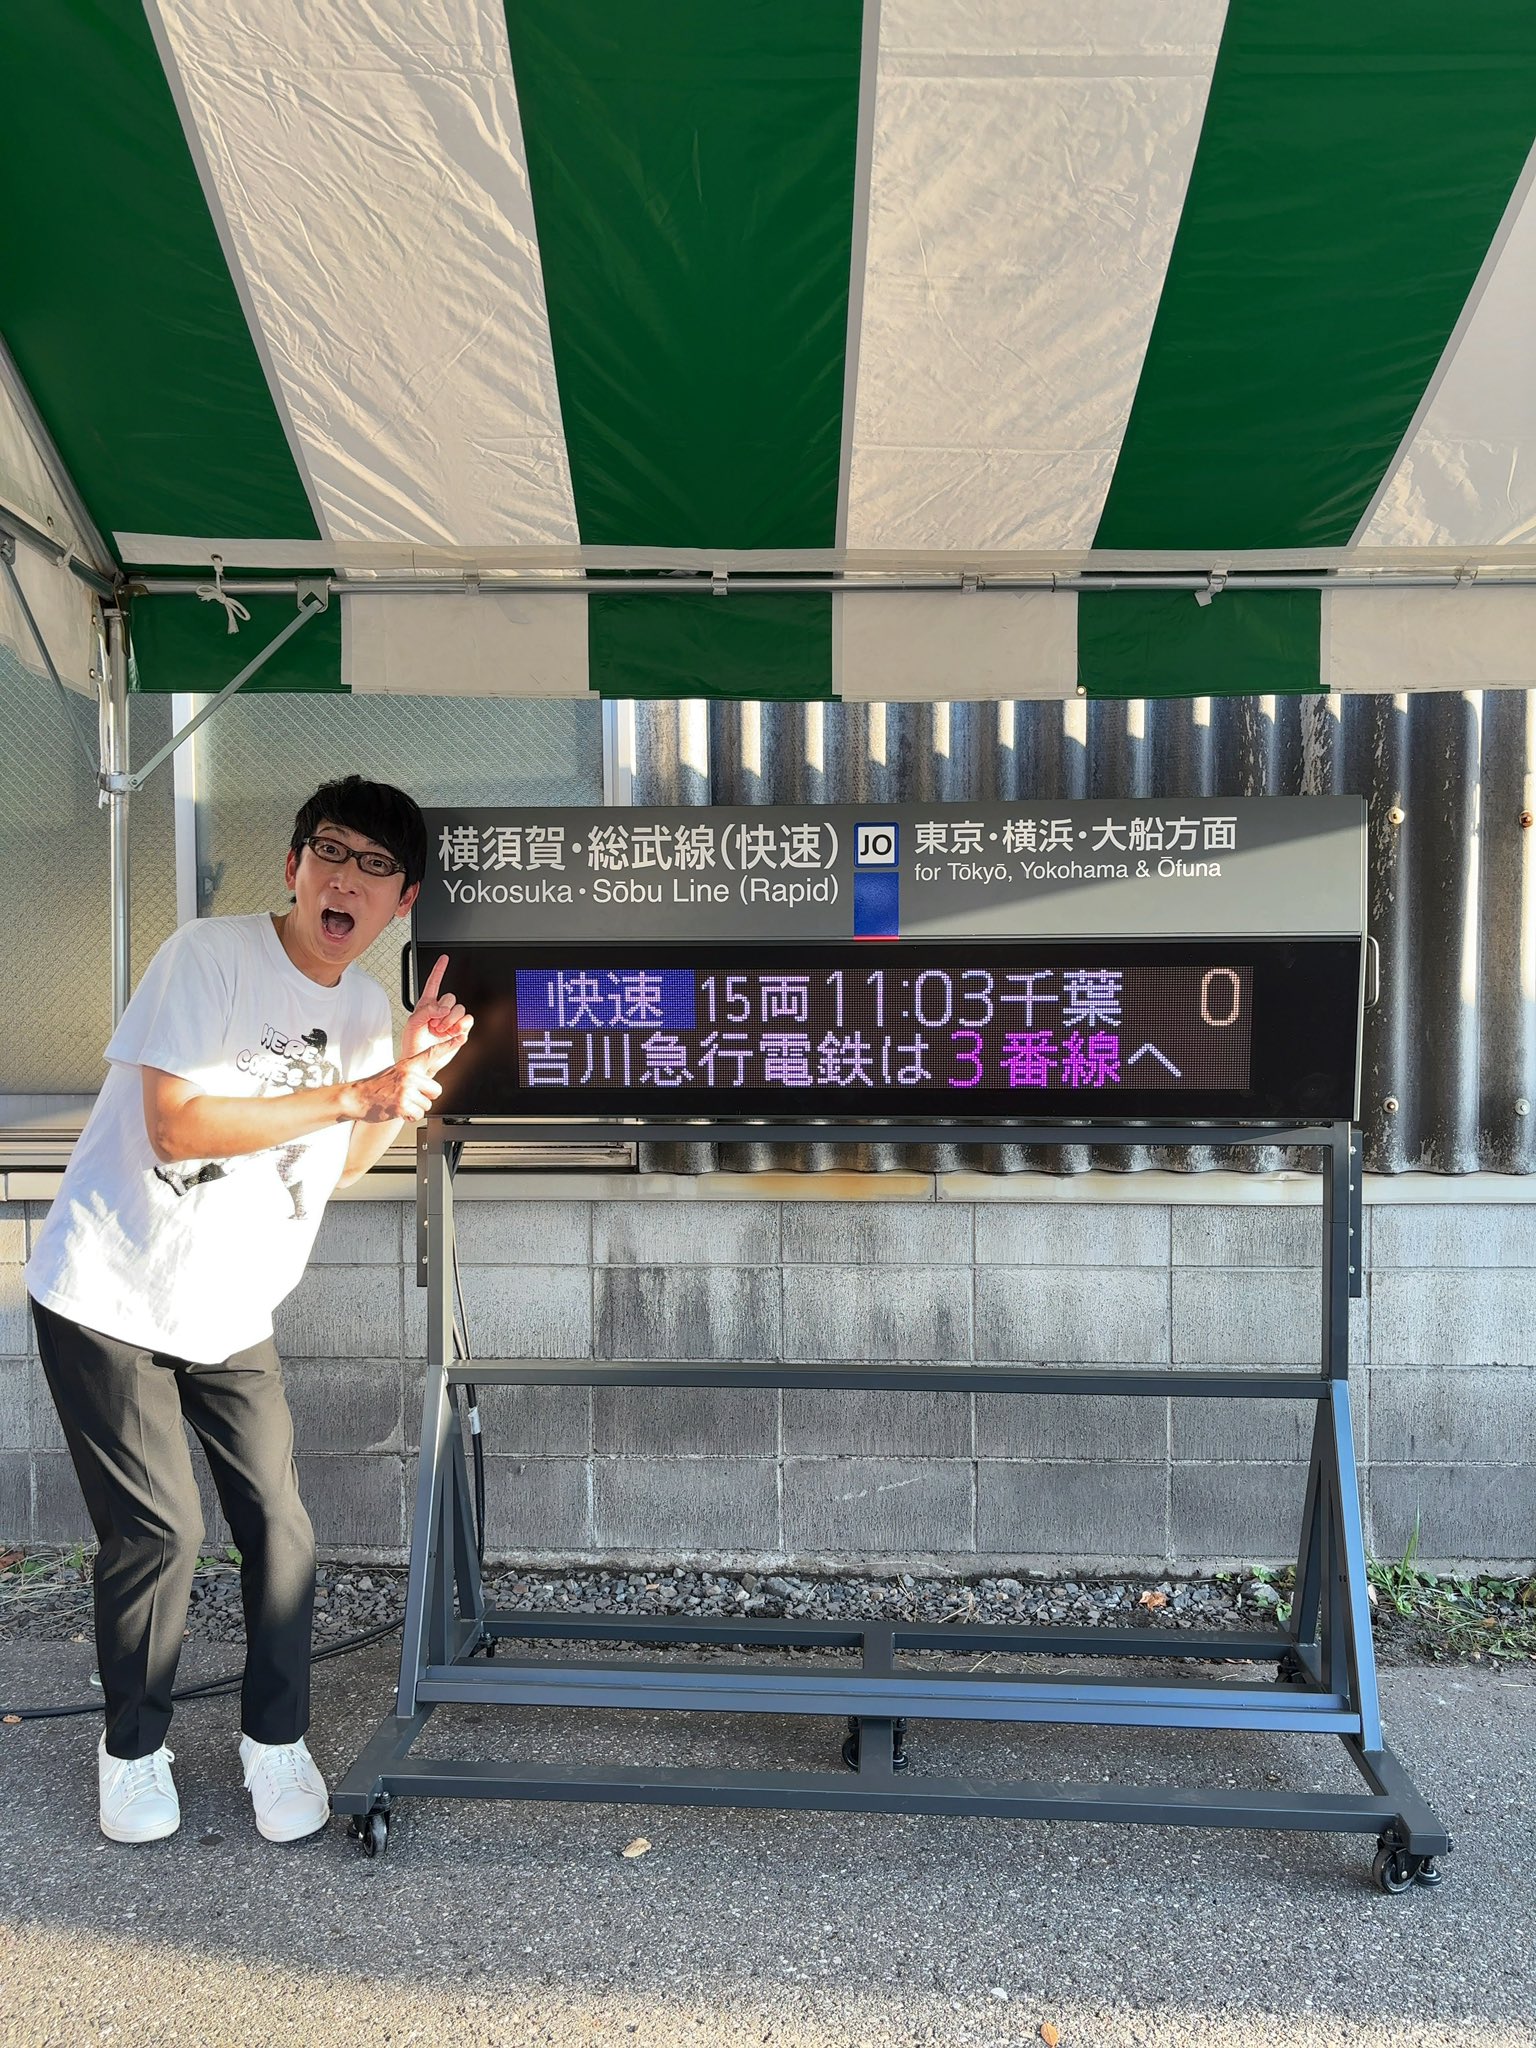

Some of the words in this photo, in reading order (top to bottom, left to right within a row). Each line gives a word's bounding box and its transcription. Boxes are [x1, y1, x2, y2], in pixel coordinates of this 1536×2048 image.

[438, 822, 838, 872] 横須賀・総武線(快速)
[860, 833, 893, 857] JO
[914, 816, 1238, 855] 東京・横浜・大船方面
[914, 862, 941, 881] for
[947, 862, 1013, 884] Tōkyō,
[1020, 860, 1129, 880] Yokohama
[1135, 860, 1151, 878] &
[1157, 855, 1222, 878] Ōfuna
[673, 878, 729, 902] Line
[739, 874, 839, 907] (Rapid)
[548, 971, 663, 1027] 快速
[260, 1023, 319, 1064] HERE
